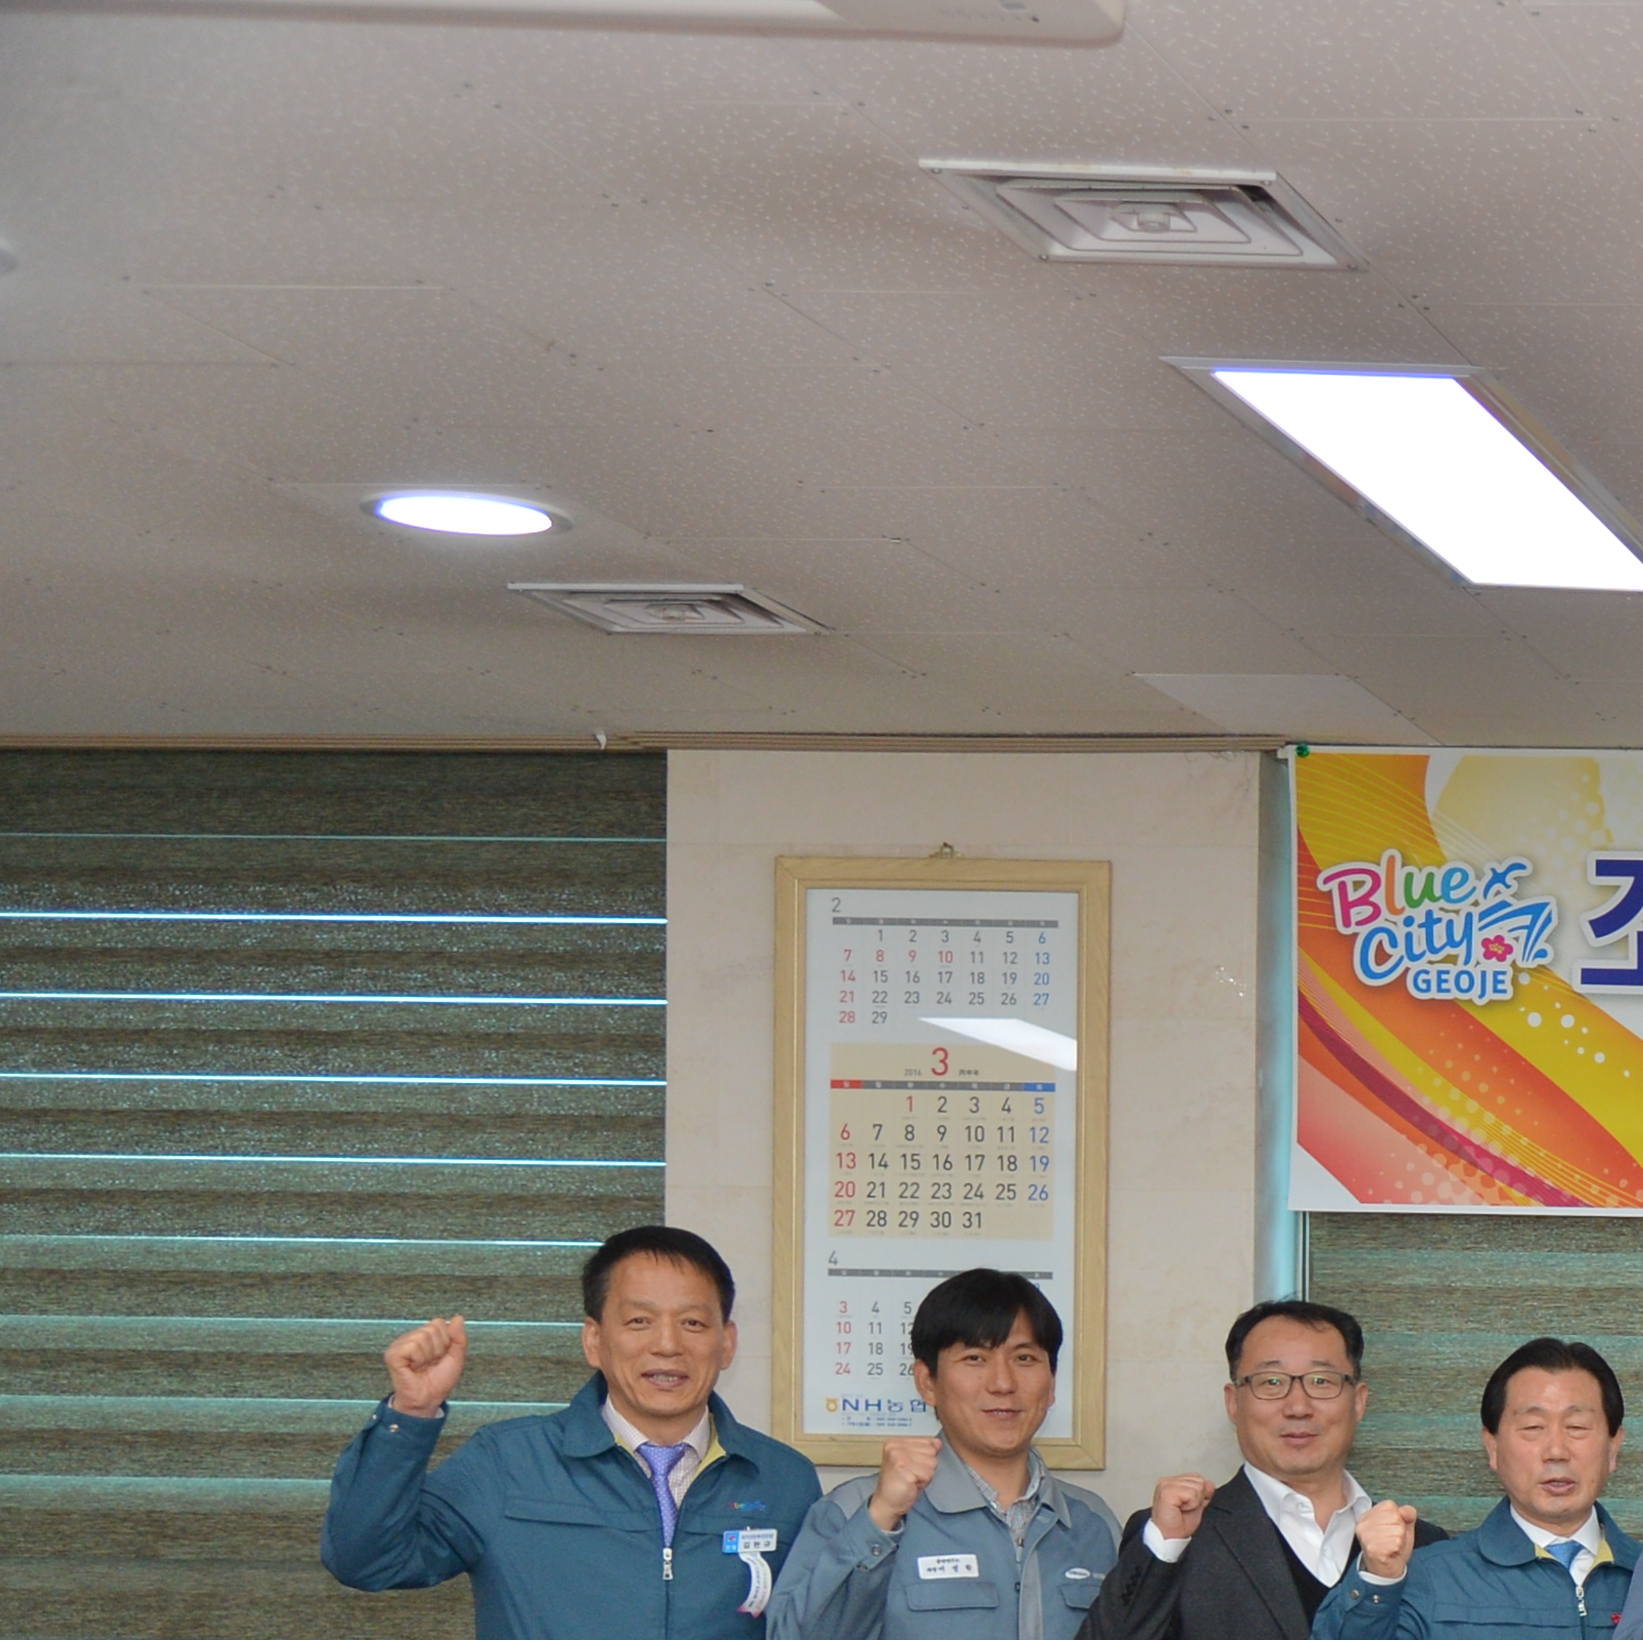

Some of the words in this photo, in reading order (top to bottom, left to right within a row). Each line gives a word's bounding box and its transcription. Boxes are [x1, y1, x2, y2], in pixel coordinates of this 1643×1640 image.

[1323, 855, 1476, 927] Blue
[831, 897, 841, 913] 2
[877, 928, 884, 942] 1
[908, 929, 918, 943] 2
[941, 929, 950, 944] 3
[972, 930, 982, 944] 4
[1005, 930, 1014, 944] 5
[1037, 931, 1047, 945] 6
[1360, 910, 1473, 980] City
[843, 948, 853, 962] 7
[875, 948, 885, 963] 8
[908, 949, 917, 963] 9
[938, 950, 954, 964] 10
[970, 950, 984, 964] 11
[1002, 951, 1018, 965] 12
[1035, 951, 1051, 966] 13
[840, 969, 856, 983] 14
[873, 969, 889, 984] 15
[905, 970, 921, 984] 16
[937, 970, 953, 984] 17
[969, 971, 986, 985] 18
[1002, 971, 1018, 985] 19
[1033, 971, 1050, 986] 20
[1412, 969, 1508, 999] GEOJE
[839, 989, 855, 1004] 21
[871, 990, 888, 1004] 22
[904, 990, 921, 1005] 23
[936, 990, 953, 1005] 24
[968, 991, 985, 1006] 25
[1000, 992, 1018, 1006] 26
[1033, 992, 1050, 1006] 27
[838, 1010, 856, 1024] 28
[871, 1010, 888, 1025] 29
[904, 1068, 922, 1077] 2016
[931, 1047, 949, 1077] 3
[906, 1095, 913, 1113] 1
[937, 1095, 948, 1114] 2
[968, 1095, 980, 1114] 3
[1001, 1096, 1012, 1114] 4
[1034, 1097, 1045, 1115] 5
[840, 1122, 851, 1141] 6
[872, 1123, 883, 1141] 7
[903, 1123, 915, 1142] 8
[936, 1124, 947, 1142] 9
[964, 1125, 985, 1143] 10
[996, 1125, 1015, 1143] 11
[1029, 1126, 1050, 1144] 12
[835, 1151, 857, 1170] 13
[868, 1152, 889, 1170] 14
[900, 1152, 921, 1171] 15
[932, 1153, 953, 1171] 16
[964, 1153, 986, 1171] 17
[996, 1154, 1018, 1172] 18
[1029, 1155, 1050, 1172] 19
[834, 1180, 856, 1198] 20
[866, 1180, 885, 1199] 21
[898, 1181, 920, 1200] 22
[930, 1181, 952, 1200] 23
[962, 1182, 984, 1200] 24
[995, 1182, 1017, 1201] 25
[1027, 1183, 1049, 1201] 26
[833, 1209, 856, 1227] 27
[866, 1209, 887, 1228] 28
[897, 1210, 920, 1228] 29
[929, 1210, 952, 1229] 30
[962, 1211, 982, 1229] 31
[828, 1250, 838, 1266] 4
[839, 1300, 848, 1314] 3
[871, 1301, 880, 1314] 4
[904, 1301, 913, 1315] 5
[836, 1321, 852, 1335] 10
[868, 1321, 882, 1335] 11
[836, 1341, 852, 1355] 17
[868, 1341, 884, 1356] 18
[835, 1361, 851, 1375] 24
[866, 1362, 884, 1376] 25
[842, 1398, 927, 1413] NH농협
